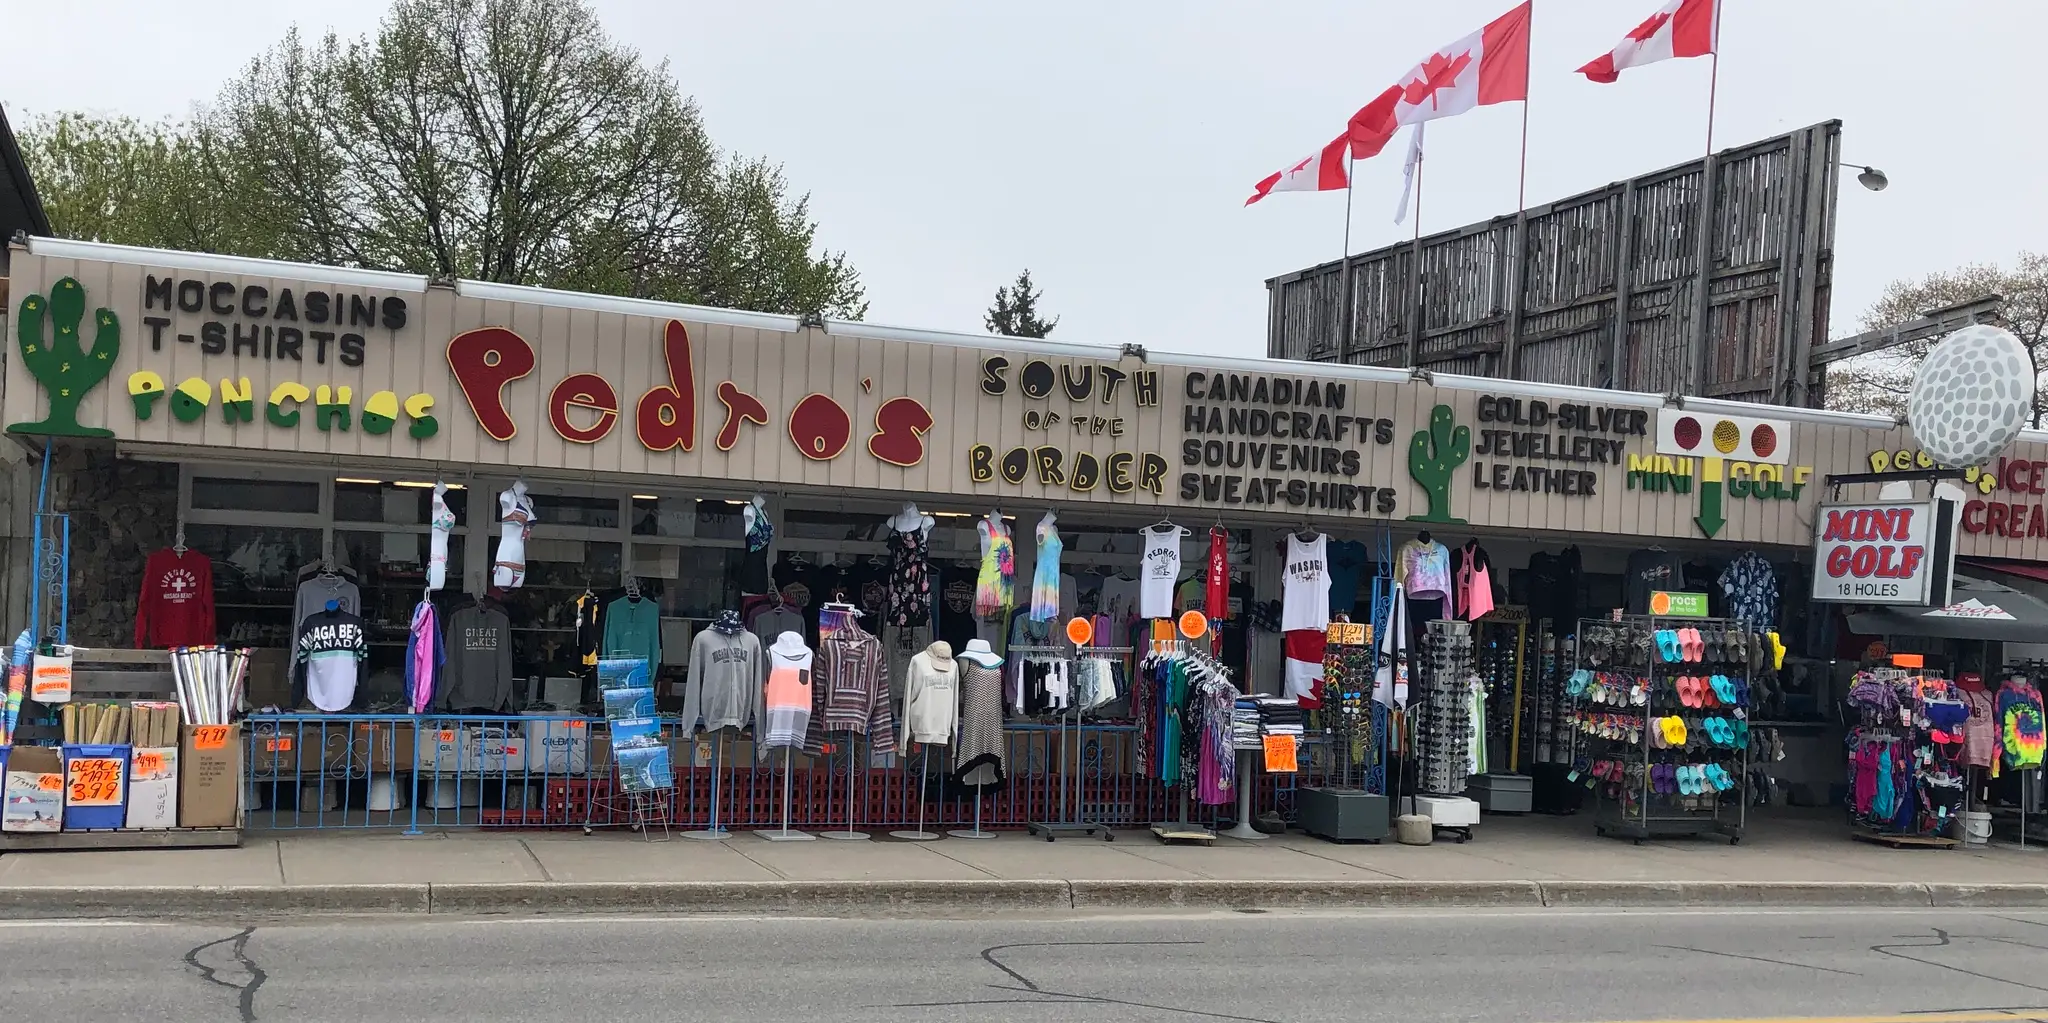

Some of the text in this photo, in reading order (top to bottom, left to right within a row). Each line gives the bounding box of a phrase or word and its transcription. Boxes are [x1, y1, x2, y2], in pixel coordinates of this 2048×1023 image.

[144, 274, 408, 330] MOCCASINS
[144, 316, 367, 367] T-SHIRTS
[446, 319, 935, 467] Pedro's
[981, 356, 1159, 407] SOUTH
[1185, 371, 1347, 410] CANADIAN
[128, 371, 439, 439] PONCHOS
[1023, 409, 1125, 437] OF THE
[1183, 404, 1394, 445] HANDCRAFTS
[1477, 395, 1649, 436] GOLD-SILVER
[1182, 438, 1361, 476] SOUVENIRS
[1475, 429, 1626, 466] JEWELLERY
[969, 443, 1168, 496] BORDER
[1473, 461, 1597, 497] LEATHER
[1626, 453, 1813, 502] MINI GOLF
[1997, 456, 2048, 496] ICE
[1180, 472, 1397, 514] SWEAT-SHIRTS
[1822, 508, 1914, 542] MINI
[1147, 548, 1177, 562] PEDROS
[1826, 545, 1924, 579] GOLF
[1670, 596, 1697, 606] rocs
[1837, 583, 1899, 597] 18 HOLES
[70, 760, 122, 773] BEACH
[80, 770, 121, 781] MATS
